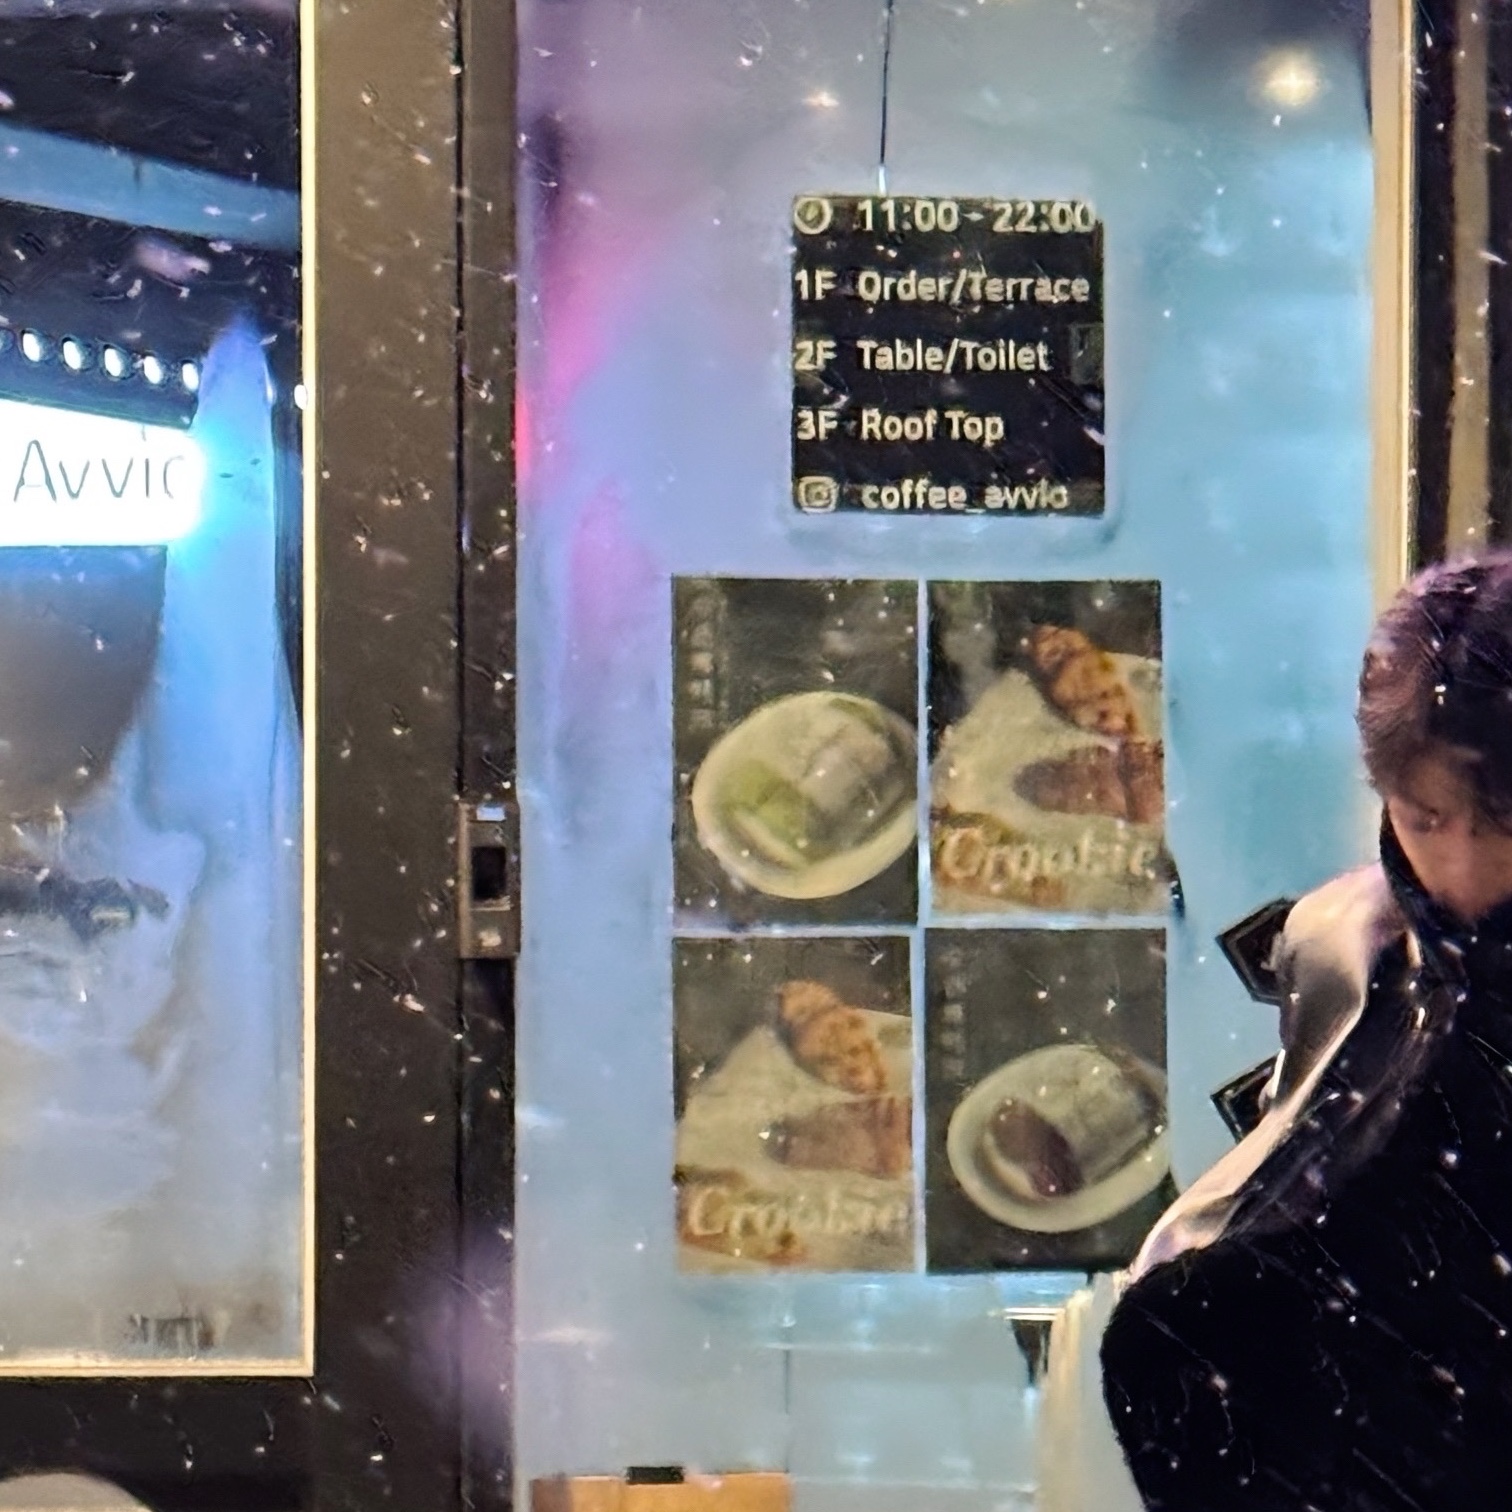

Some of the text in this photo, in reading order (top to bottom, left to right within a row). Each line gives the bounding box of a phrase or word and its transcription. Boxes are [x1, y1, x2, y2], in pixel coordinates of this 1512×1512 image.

[857, 198, 960, 233] 11:00
[992, 200, 1096, 234] 22:00
[795, 268, 1090, 303] 1F Order/Terrace
[795, 338, 1050, 373] 2F Table/Toilet
[797, 408, 1005, 448] 3F Roof Top
